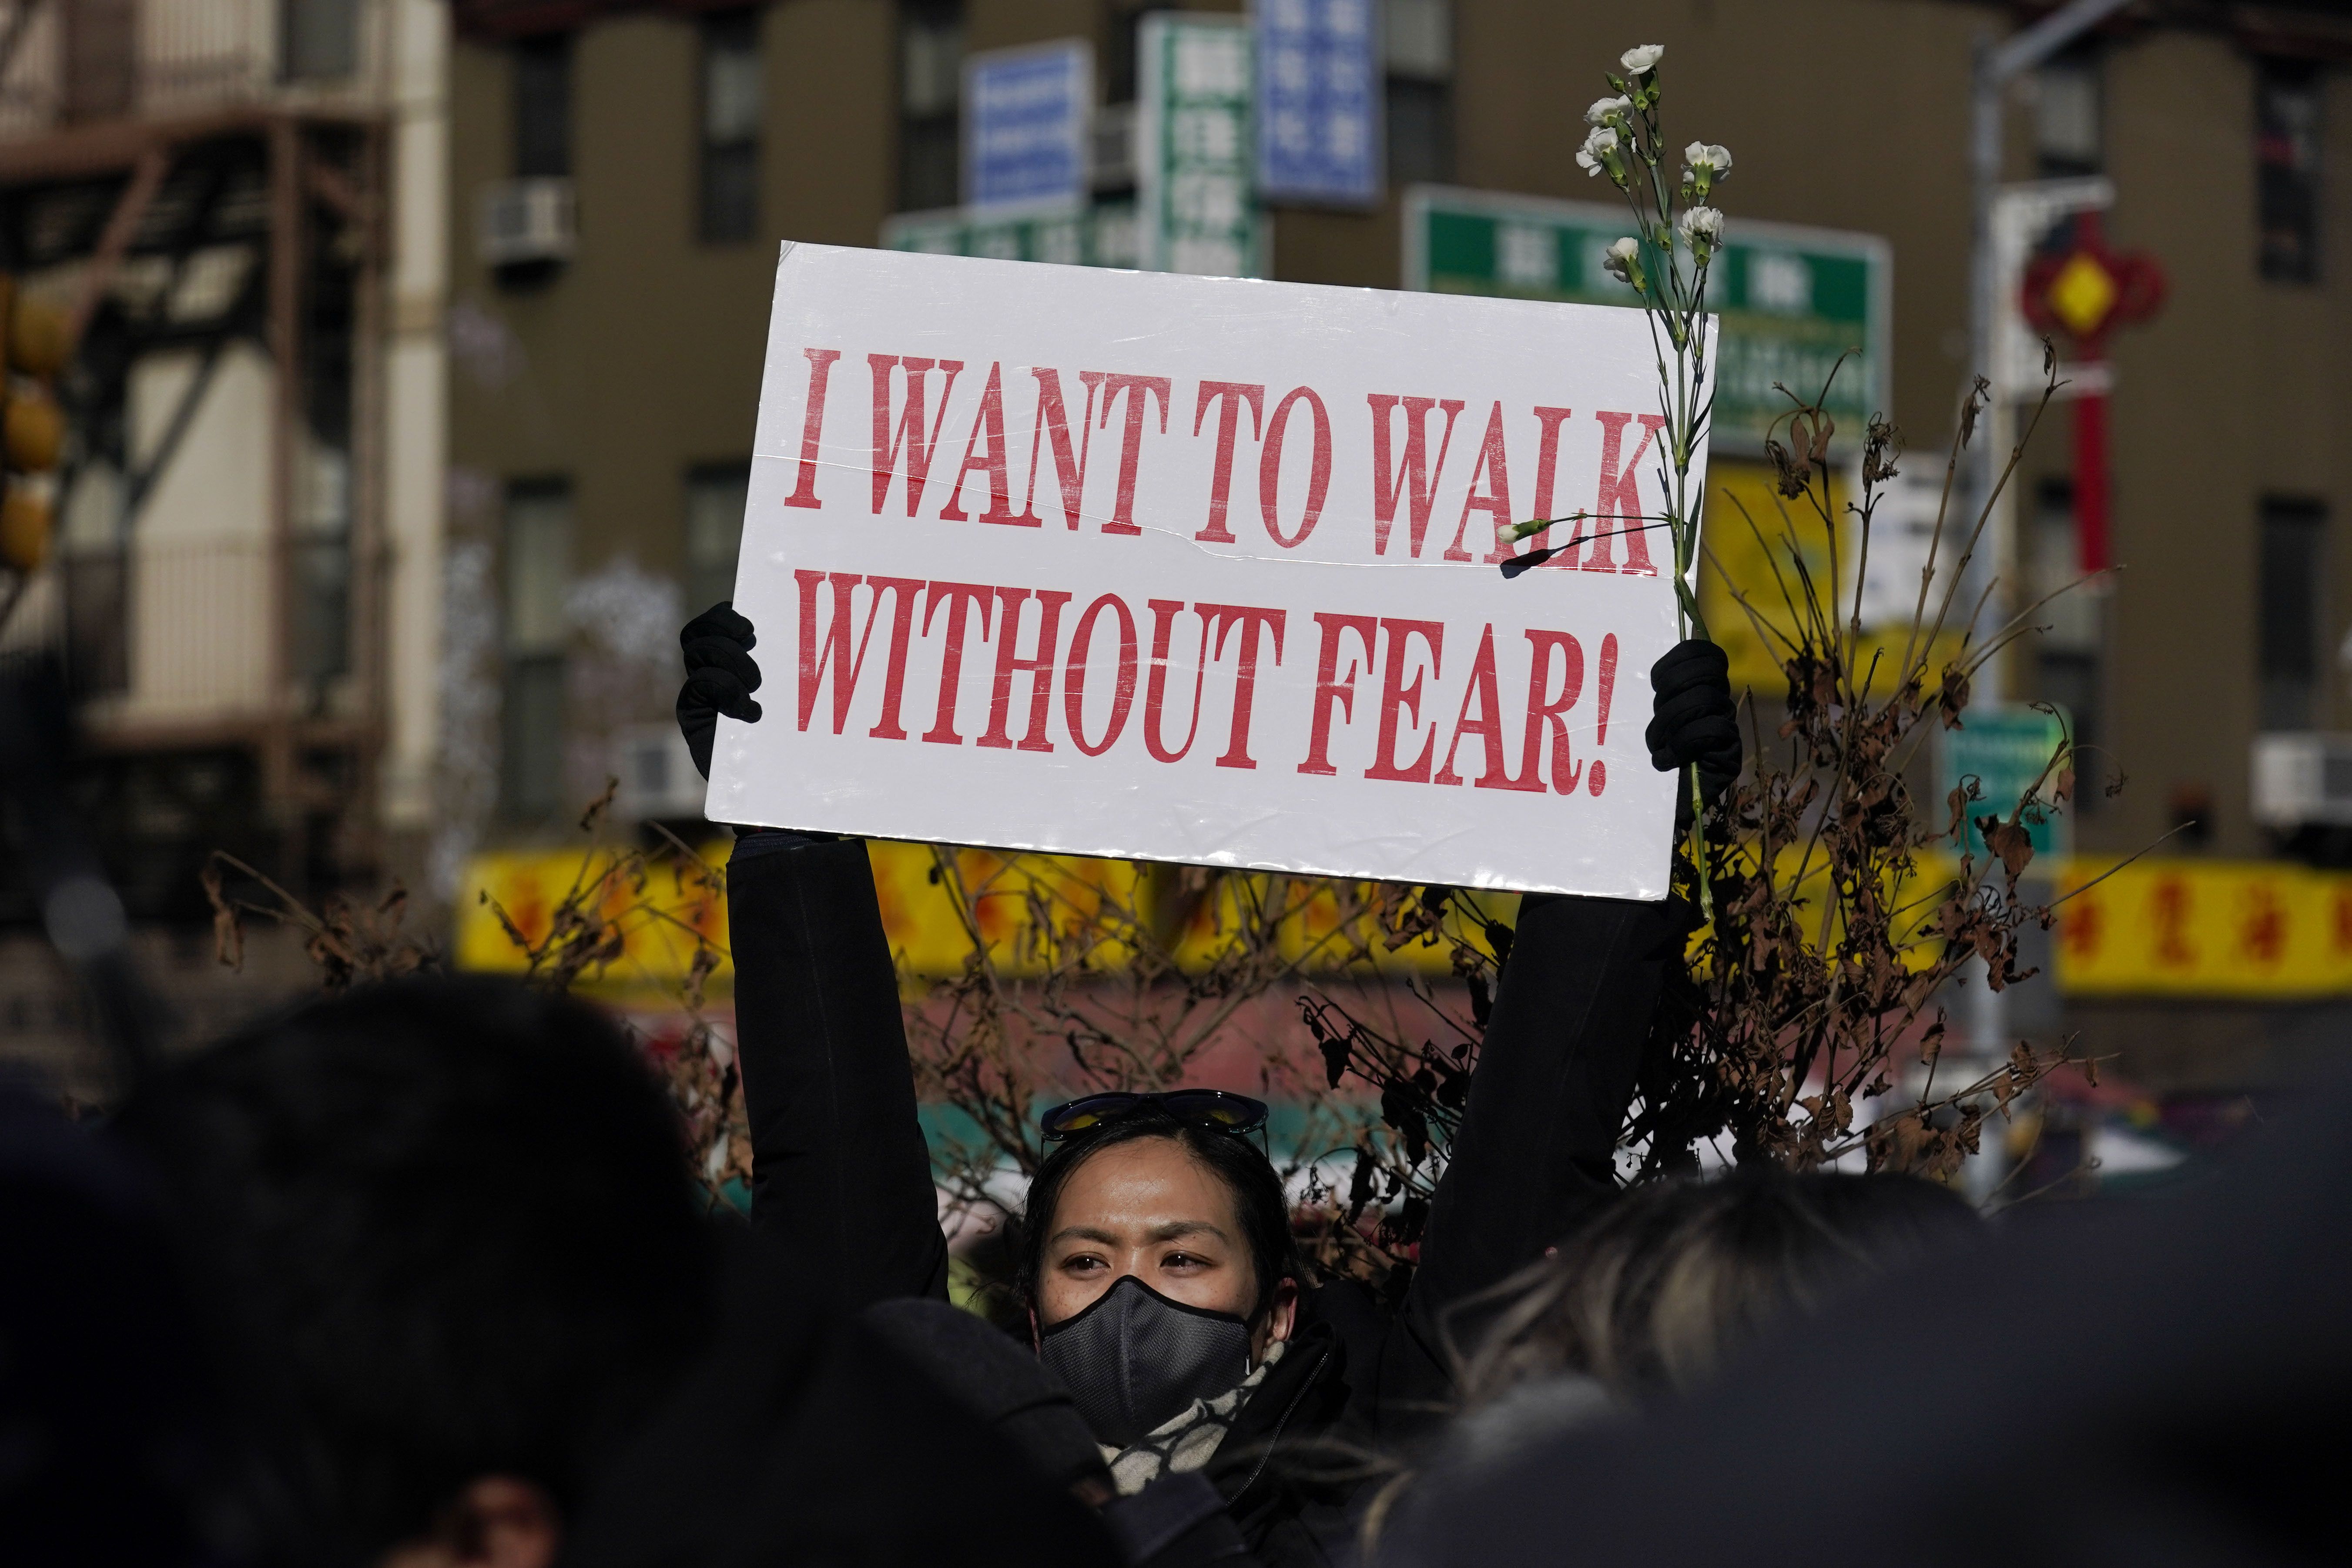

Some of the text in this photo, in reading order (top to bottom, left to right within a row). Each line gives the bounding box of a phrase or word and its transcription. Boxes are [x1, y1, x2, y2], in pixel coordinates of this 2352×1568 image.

[784, 348, 1666, 577] I WANT TO WALK
[794, 569, 1618, 797] WITHOUT FEAR!
